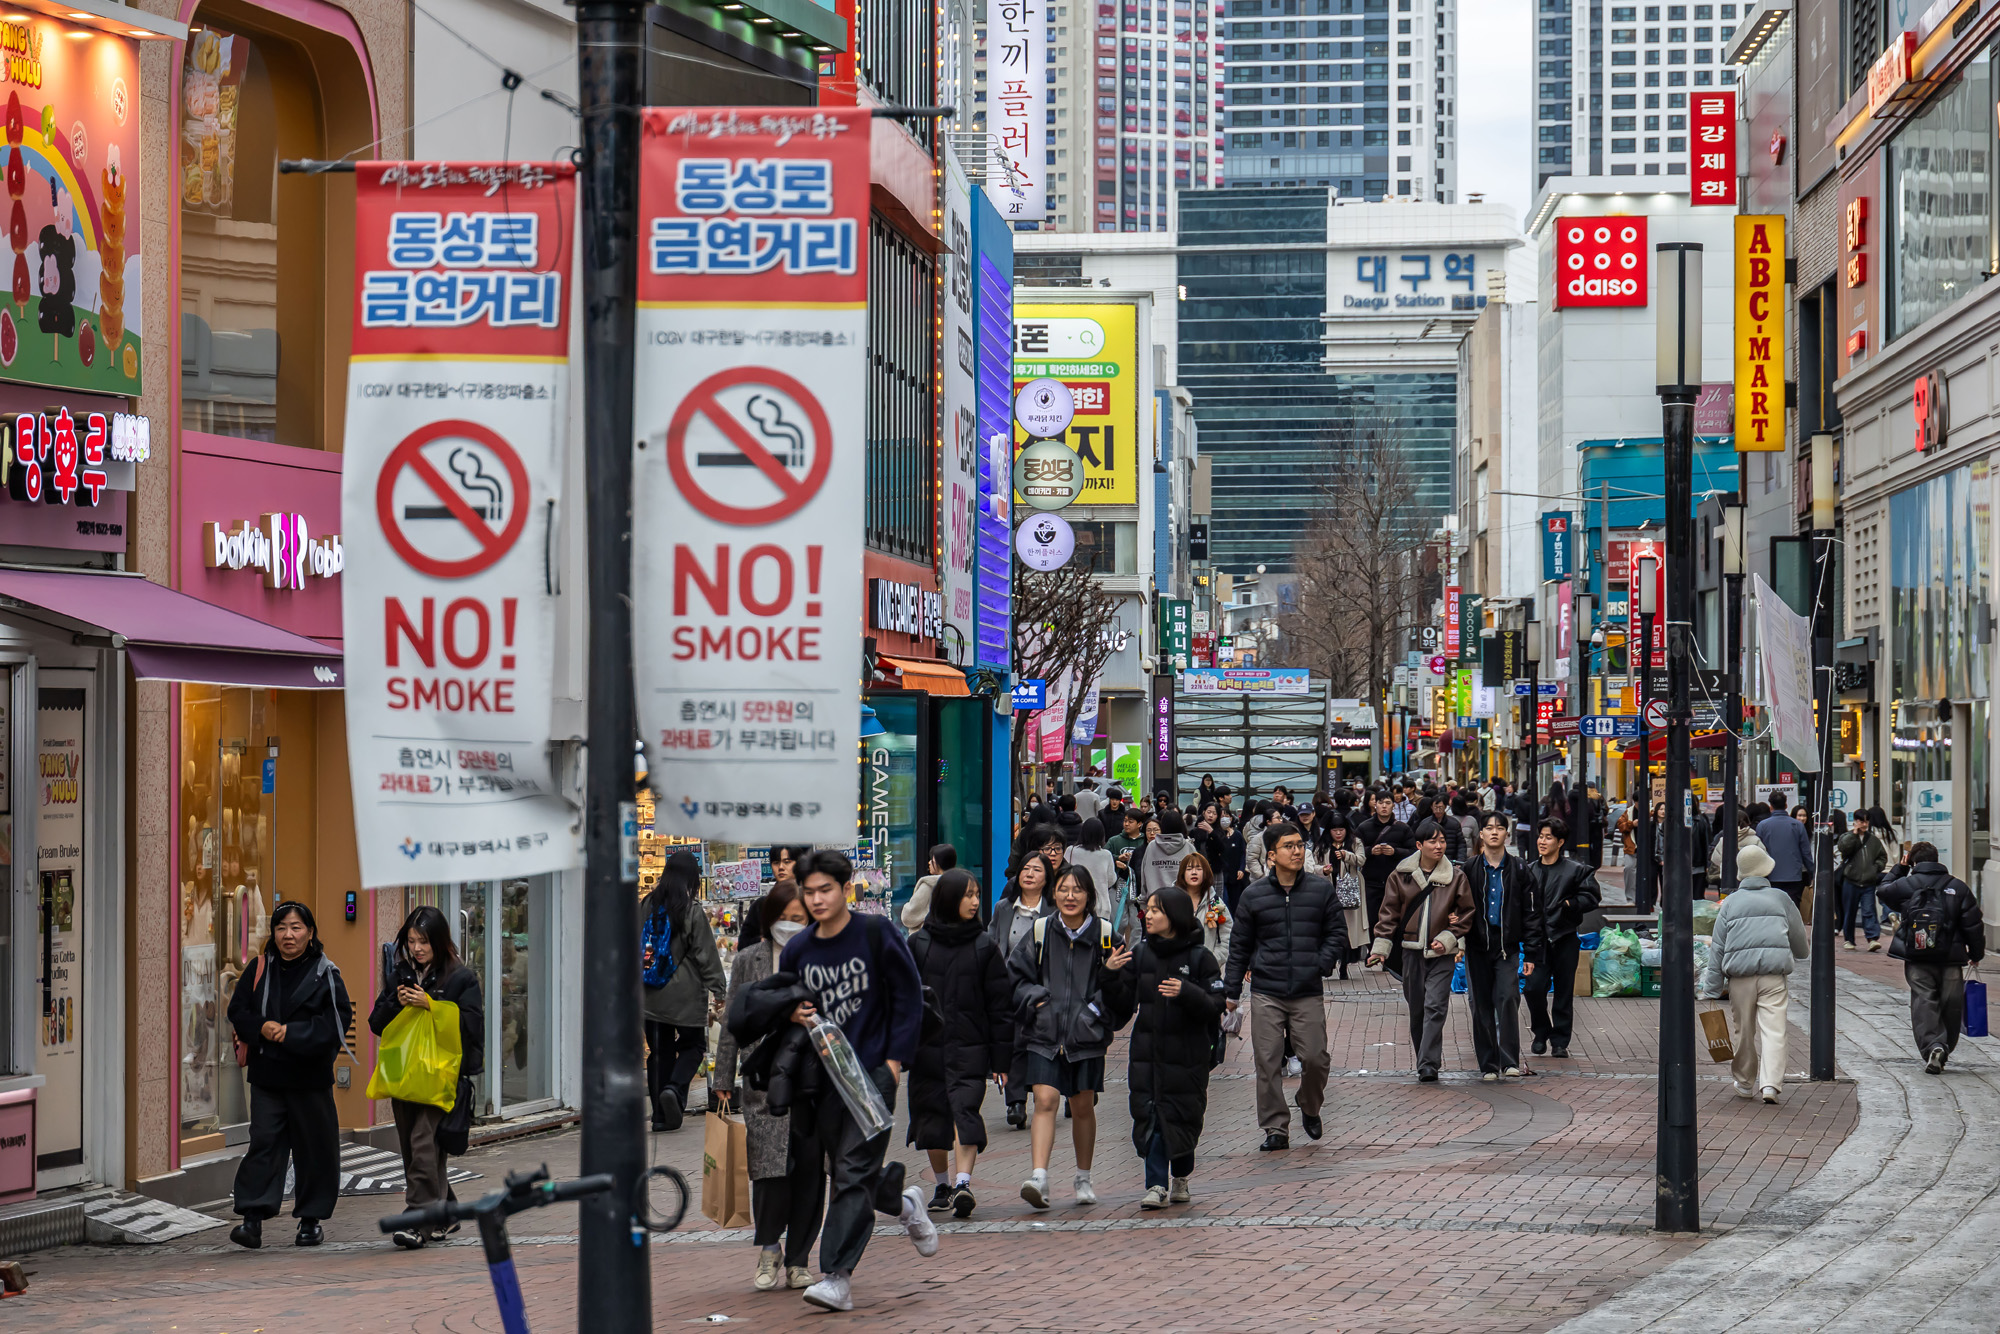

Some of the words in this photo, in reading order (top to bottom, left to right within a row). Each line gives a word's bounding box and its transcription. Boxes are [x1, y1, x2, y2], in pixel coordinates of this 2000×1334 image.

[10, 54, 42, 90] HULU
[1700, 99, 1728, 197] 금강제화
[676, 158, 833, 215] 동성로
[1008, 203, 1024, 214] 2F
[388, 212, 539, 269] 동성로
[650, 217, 858, 276] 금연거리
[1357, 253, 1476, 293] 대구역
[1568, 275, 1638, 297] daiso
[361, 270, 562, 329] 금연거리
[1344, 295, 1389, 311] Daegu
[1395, 293, 1445, 308] Station
[656, 330, 686, 346] CGV
[1748, 223, 1772, 443] ABC-MART
[1049, 364, 1104, 376] 확인하세요!
[363, 383, 393, 398] CGV
[1027, 414, 1048, 423] 푸라닭
[1048, 414, 1063, 423] 치킨
[1027, 487, 1052, 496] 베이커리
[1085, 477, 1115, 490] 까지!
[1027, 547, 1063, 557] 한끼플러스
[1554, 533, 1564, 575] 7번가피자
[672, 543, 824, 617] NO!
[384, 596, 519, 670] NO!
[1465, 598, 1475, 655] CROCODIL
[671, 625, 822, 661] SMOKE
[386, 677, 516, 713] SMOKE
[1217, 677, 1244, 691] 캐릭터
[1243, 679, 1276, 692] 스트리트
[679, 700, 736, 723] 흡연시
[742, 700, 814, 723] 5만원의
[1159, 696, 1169, 714] 쇼핑
[661, 729, 732, 751] 과태료가
[740, 729, 836, 751] 부과됩니다
[1159, 717, 1169, 762] 핫플레이스
[39, 753, 65, 778] TANG
[398, 747, 451, 769] 흡연시
[458, 750, 515, 773] 5만원의
[52, 779, 78, 804] HULU
[379, 773, 450, 795] 과태료가
[704, 801, 783, 818] 대구광역시
[872, 748, 889, 847] GAMES
[37, 845, 59, 859] Cream
[60, 843, 80, 858] Brulee
[427, 837, 511, 857] 대구광역시
[516, 833, 550, 850] 중구
